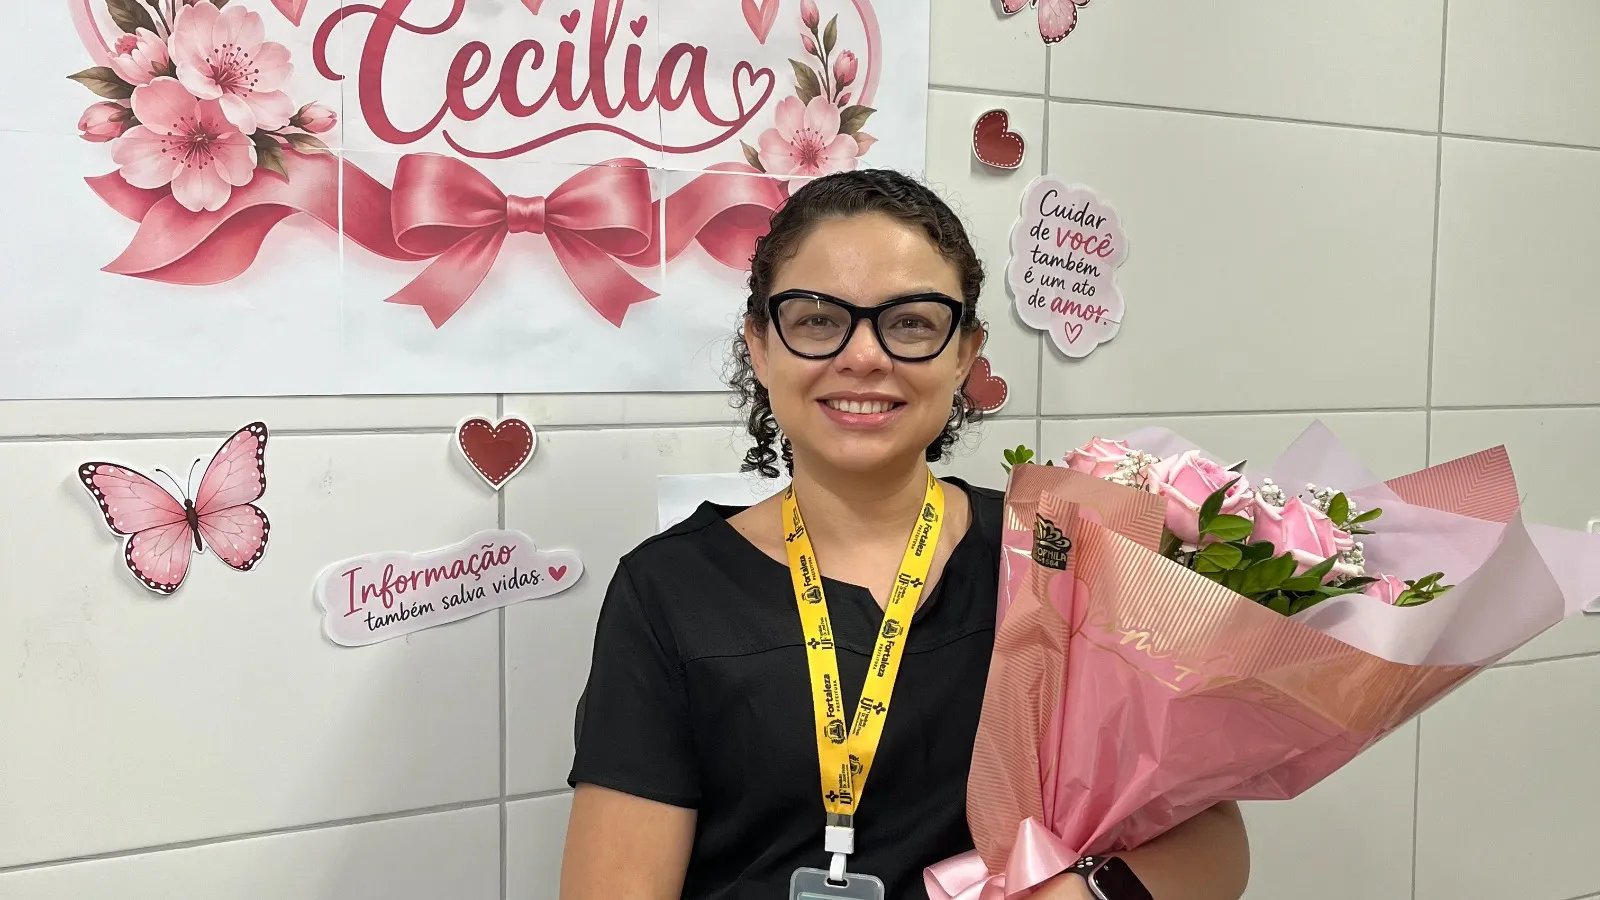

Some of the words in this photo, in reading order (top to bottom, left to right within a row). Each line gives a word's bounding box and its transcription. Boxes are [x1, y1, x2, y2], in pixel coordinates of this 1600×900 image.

[313, 0, 775, 148] Cecilia
[1039, 189, 1107, 229] Cuidar
[1030, 219, 1050, 240] de
[1056, 227, 1114, 258] você
[1030, 244, 1100, 278] também
[1024, 266, 1034, 284] é
[1040, 273, 1065, 290] um
[1072, 280, 1096, 297] ato
[1028, 288, 1046, 308] de
[1050, 296, 1109, 325] amor.
[914, 523, 933, 557] Fortaleza
[341, 542, 517, 617] Informação
[800, 555, 811, 587] Fortaleza
[364, 602, 435, 631] também
[441, 583, 486, 610] salva
[493, 567, 545, 594] vidas.
[877, 640, 896, 678] Fortaleza
[823, 674, 836, 718] Fortaleza
